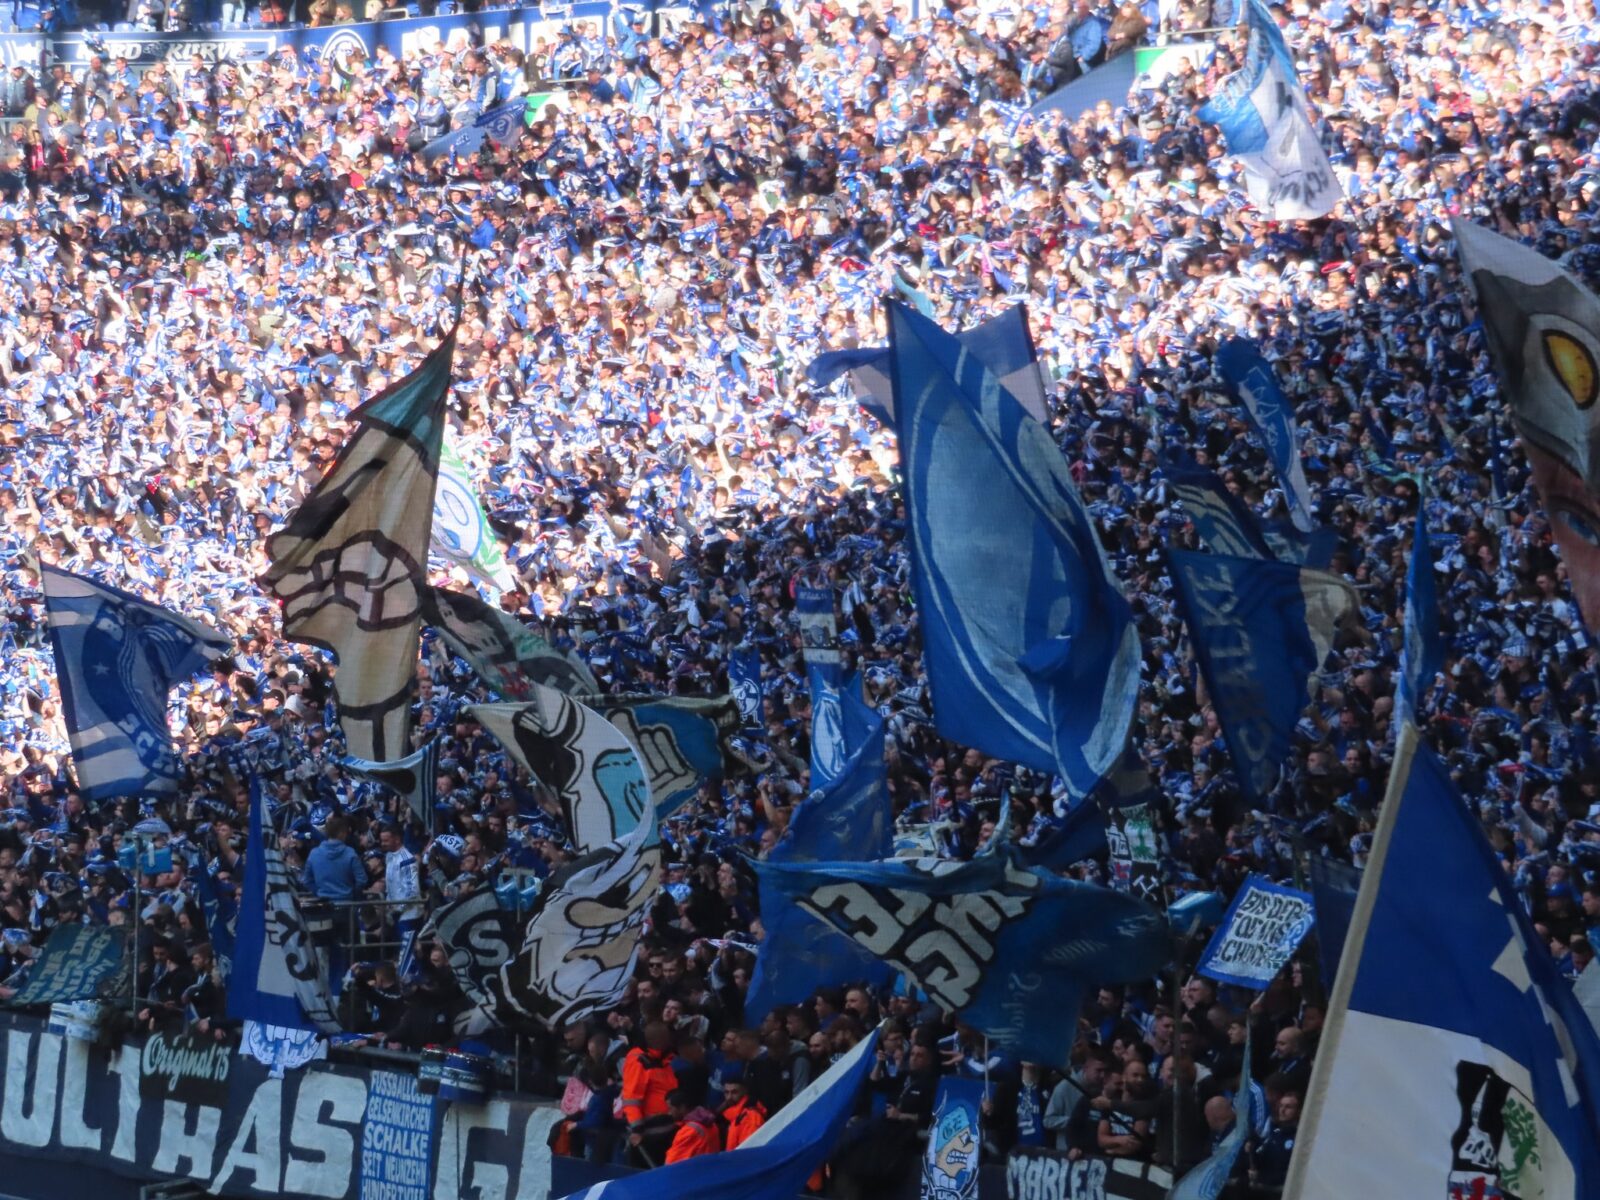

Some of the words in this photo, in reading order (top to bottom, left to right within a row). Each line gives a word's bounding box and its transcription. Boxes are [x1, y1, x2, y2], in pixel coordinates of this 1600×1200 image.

[1, 1030, 367, 1199] ULTRAS
[367, 1096, 432, 1131] GELSENKIRCHEN
[363, 1122, 429, 1158] SCHALKE
